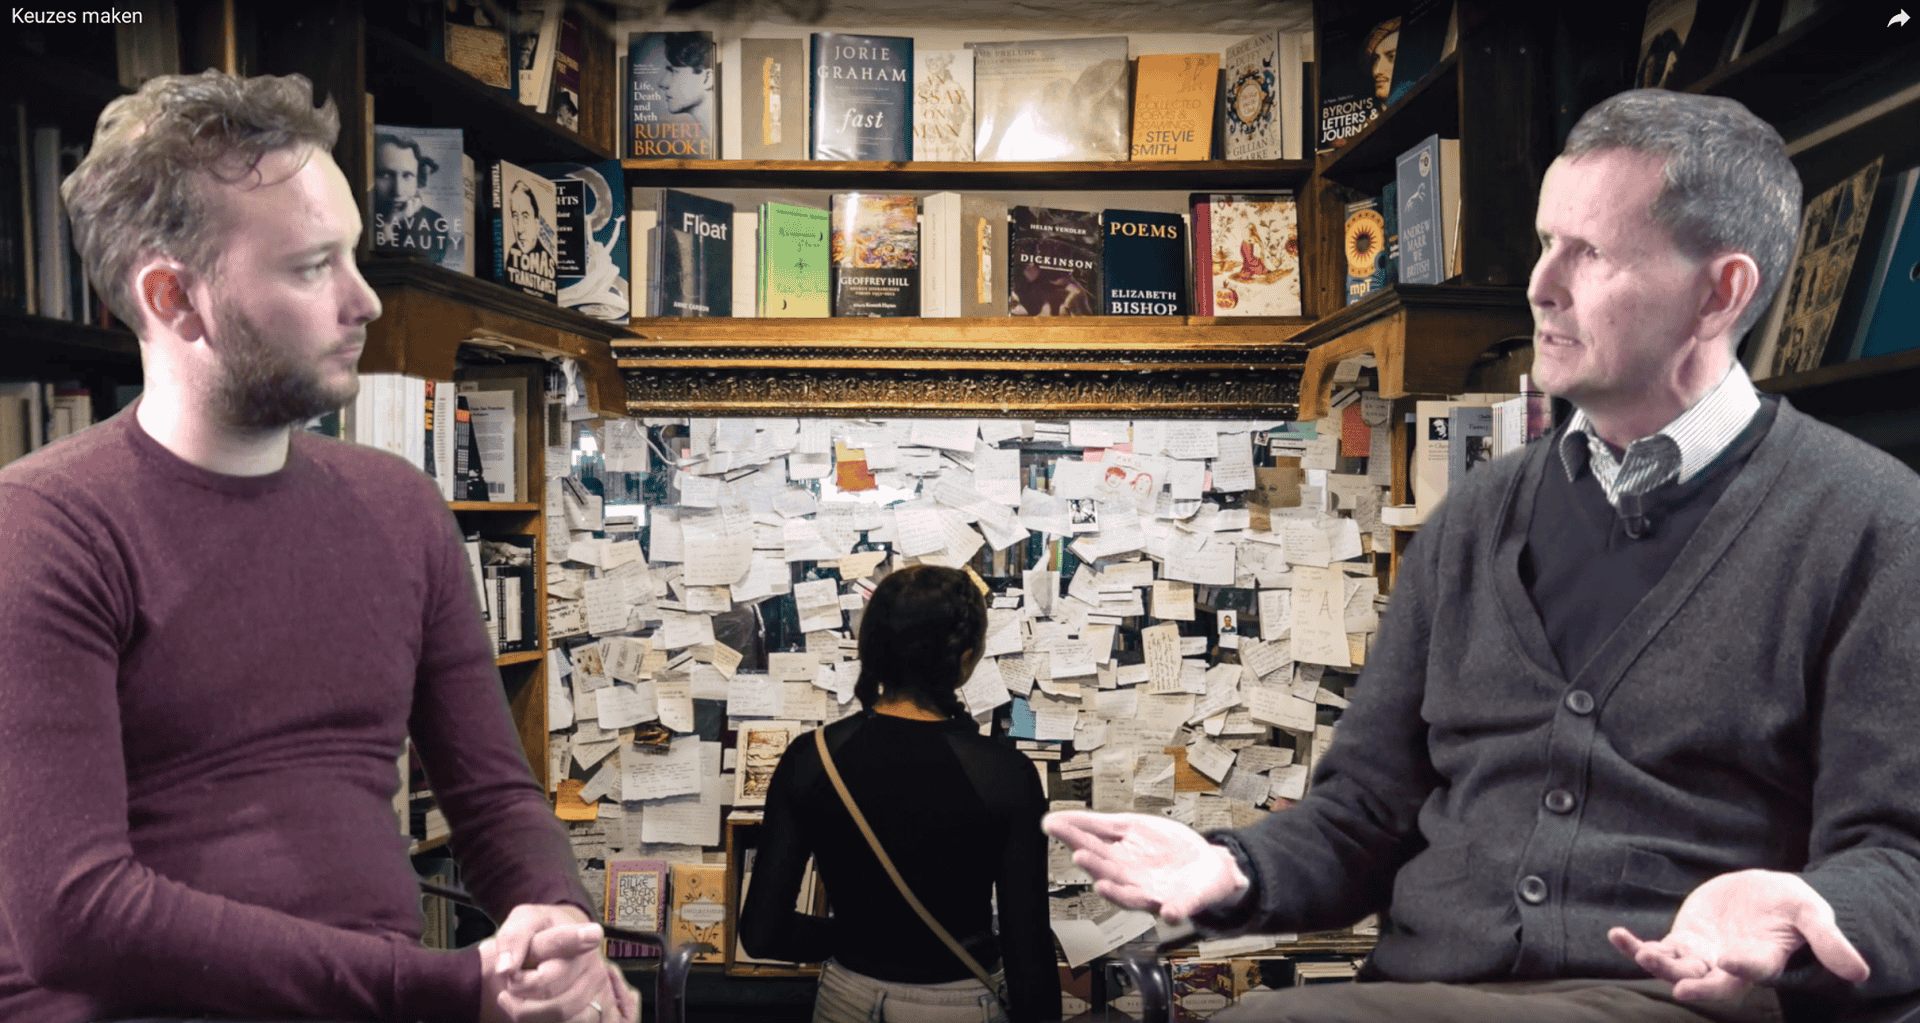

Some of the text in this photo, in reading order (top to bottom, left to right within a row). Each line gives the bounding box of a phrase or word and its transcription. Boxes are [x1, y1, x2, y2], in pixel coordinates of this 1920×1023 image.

[834, 46, 891, 61] JORIE
[817, 66, 907, 82] GRAHAM
[634, 81, 655, 92] Life,
[634, 91, 662, 101] Death
[634, 102, 651, 112] and
[1323, 97, 1374, 119] BYRON'S
[634, 112, 659, 123] Myth
[837, 108, 884, 134] fast
[1322, 108, 1379, 131] LETTERS &
[635, 123, 701, 139] RUPERT
[1146, 130, 1195, 143] STEVIE
[634, 140, 710, 156] BROOKE
[1131, 143, 1178, 156] SMITH
[375, 213, 462, 233] SAVAGE
[683, 212, 727, 240] Float
[1030, 224, 1087, 236] HELEN VENDLER
[1110, 221, 1178, 240] POEMS
[376, 231, 461, 250] BEAUTY
[510, 247, 556, 280] TOMAS
[1020, 253, 1093, 270] DICKINSON
[840, 276, 910, 287] GEOFFREY HILL
[1111, 288, 1177, 301] ELIZABETH
[1111, 301, 1178, 316] BISHOP
[618, 905, 647, 916] POET
